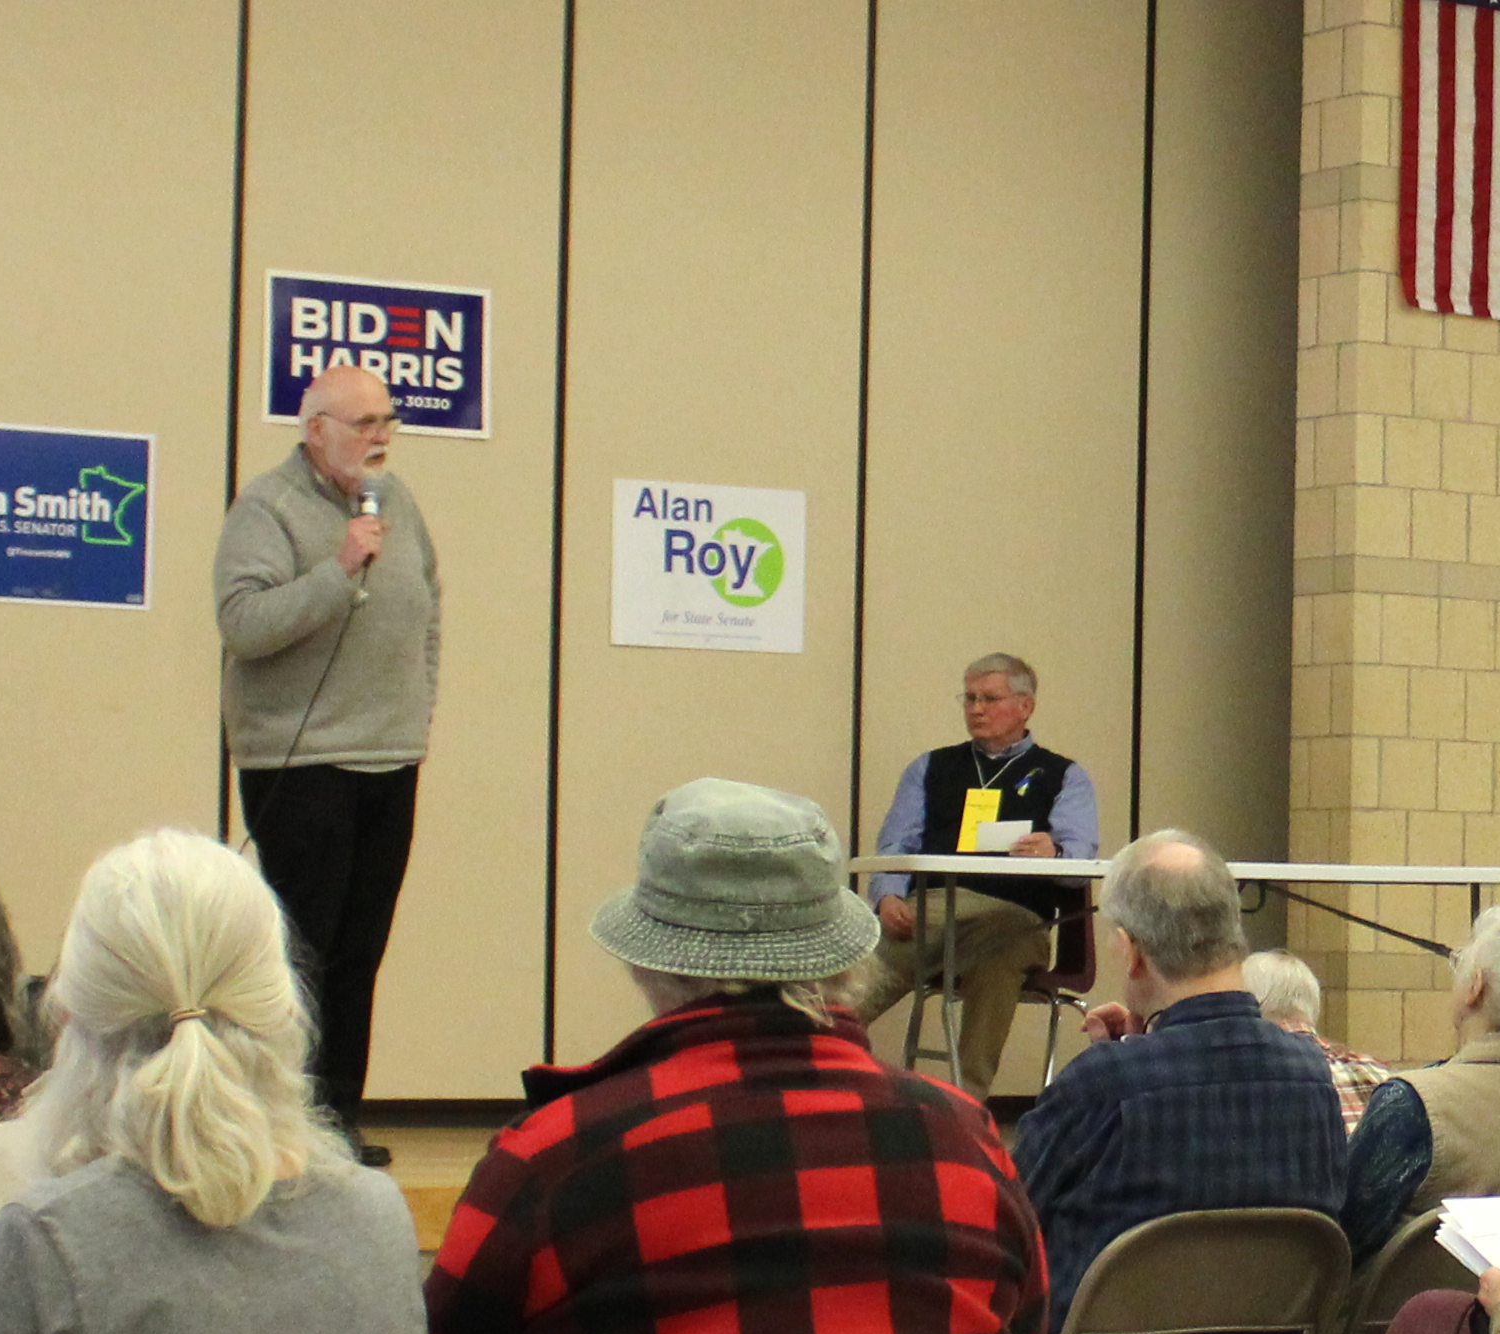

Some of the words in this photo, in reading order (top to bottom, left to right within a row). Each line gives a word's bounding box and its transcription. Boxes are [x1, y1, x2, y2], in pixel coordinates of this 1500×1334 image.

[291, 296, 464, 352] BIDEN
[290, 344, 465, 391] HARRIS
[405, 395, 452, 411] 30330
[13, 486, 112, 523] Smith
[633, 487, 713, 523] Alan
[13, 522, 78, 538] SENATOR
[664, 528, 757, 590] Roy
[661, 609, 680, 625] for
[682, 611, 713, 625] State
[716, 613, 756, 627] Senate
